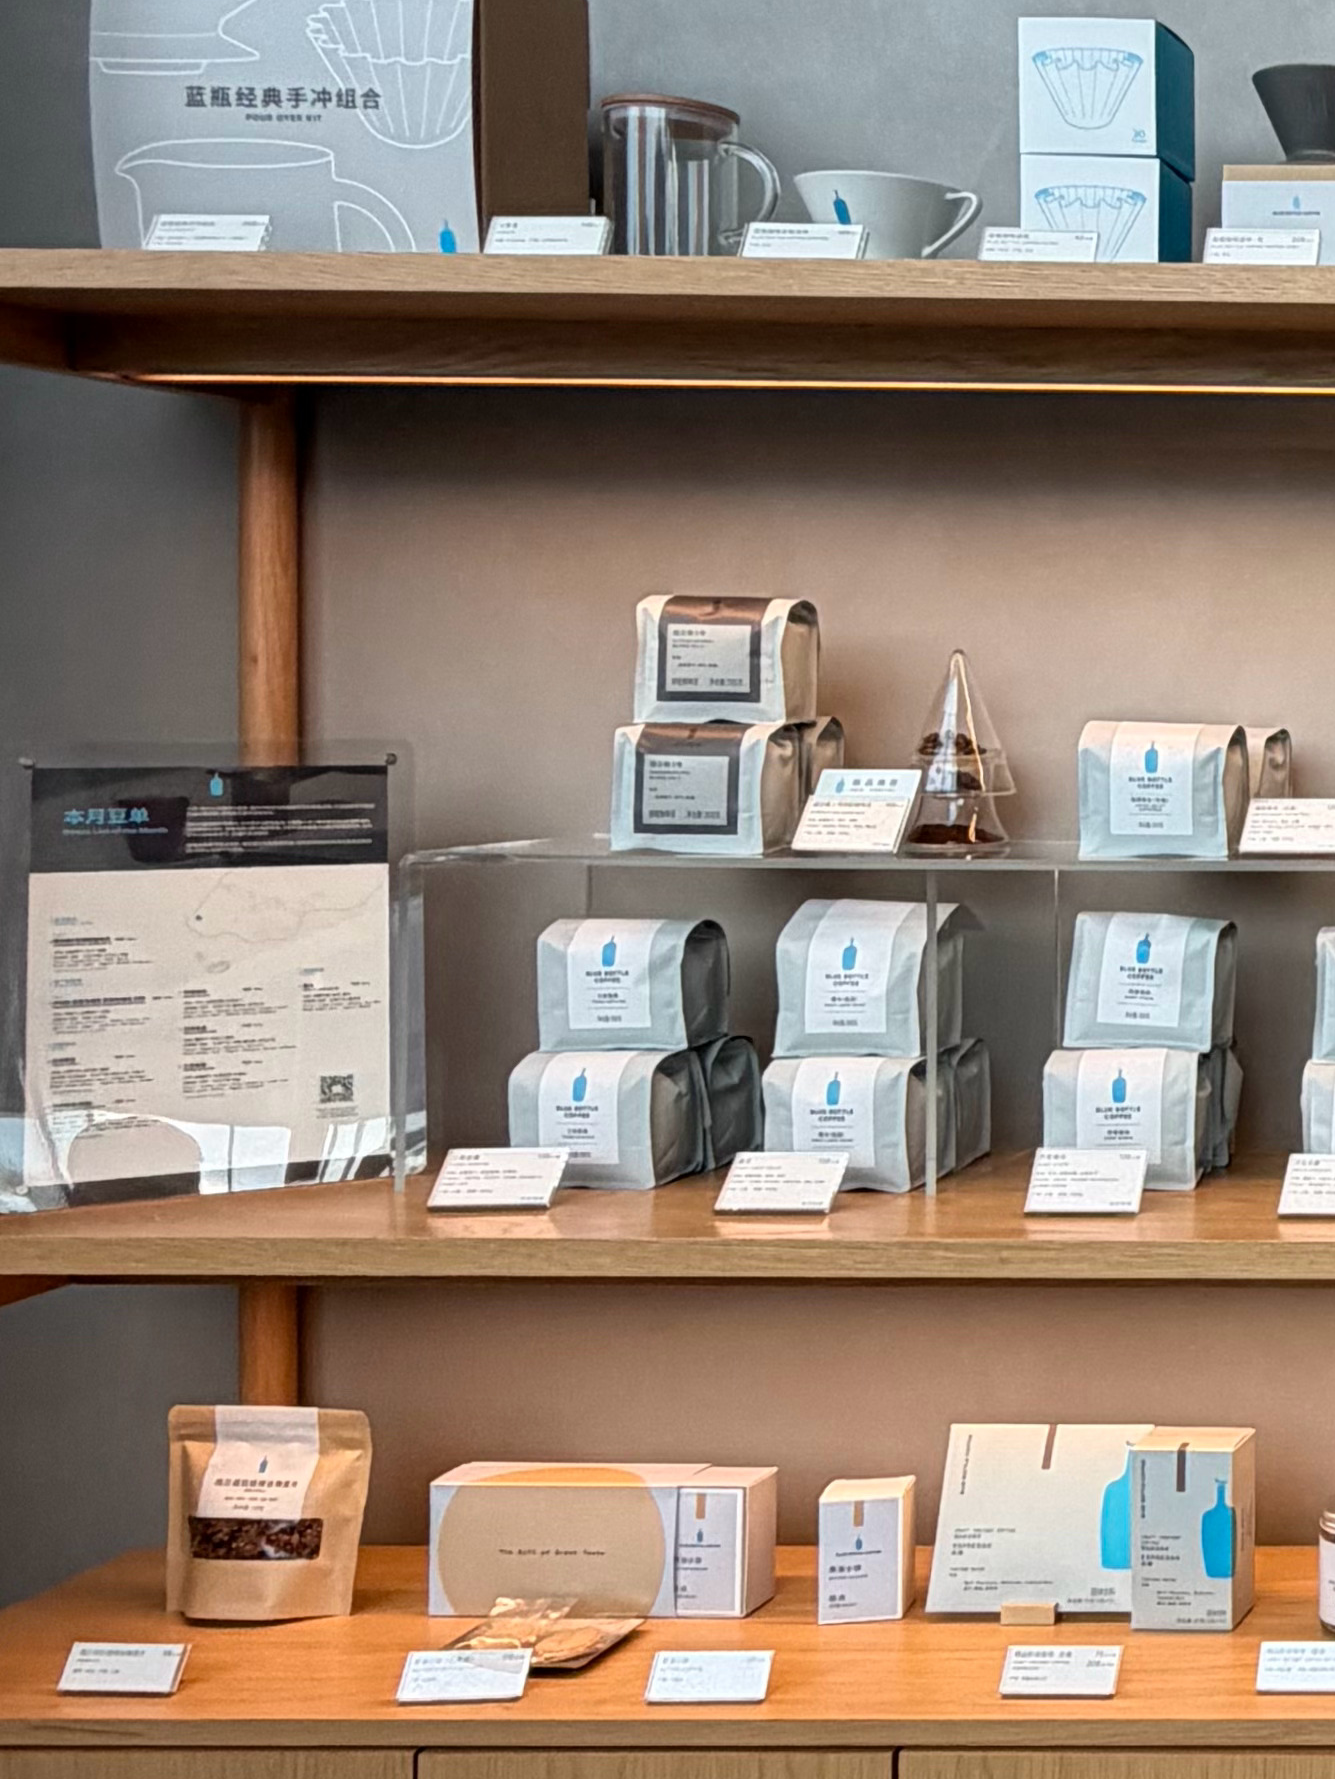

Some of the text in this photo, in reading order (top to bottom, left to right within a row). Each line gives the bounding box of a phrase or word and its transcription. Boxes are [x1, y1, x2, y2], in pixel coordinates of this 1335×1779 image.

[184, 85, 382, 110] 蓝瓶经典手冲组合
